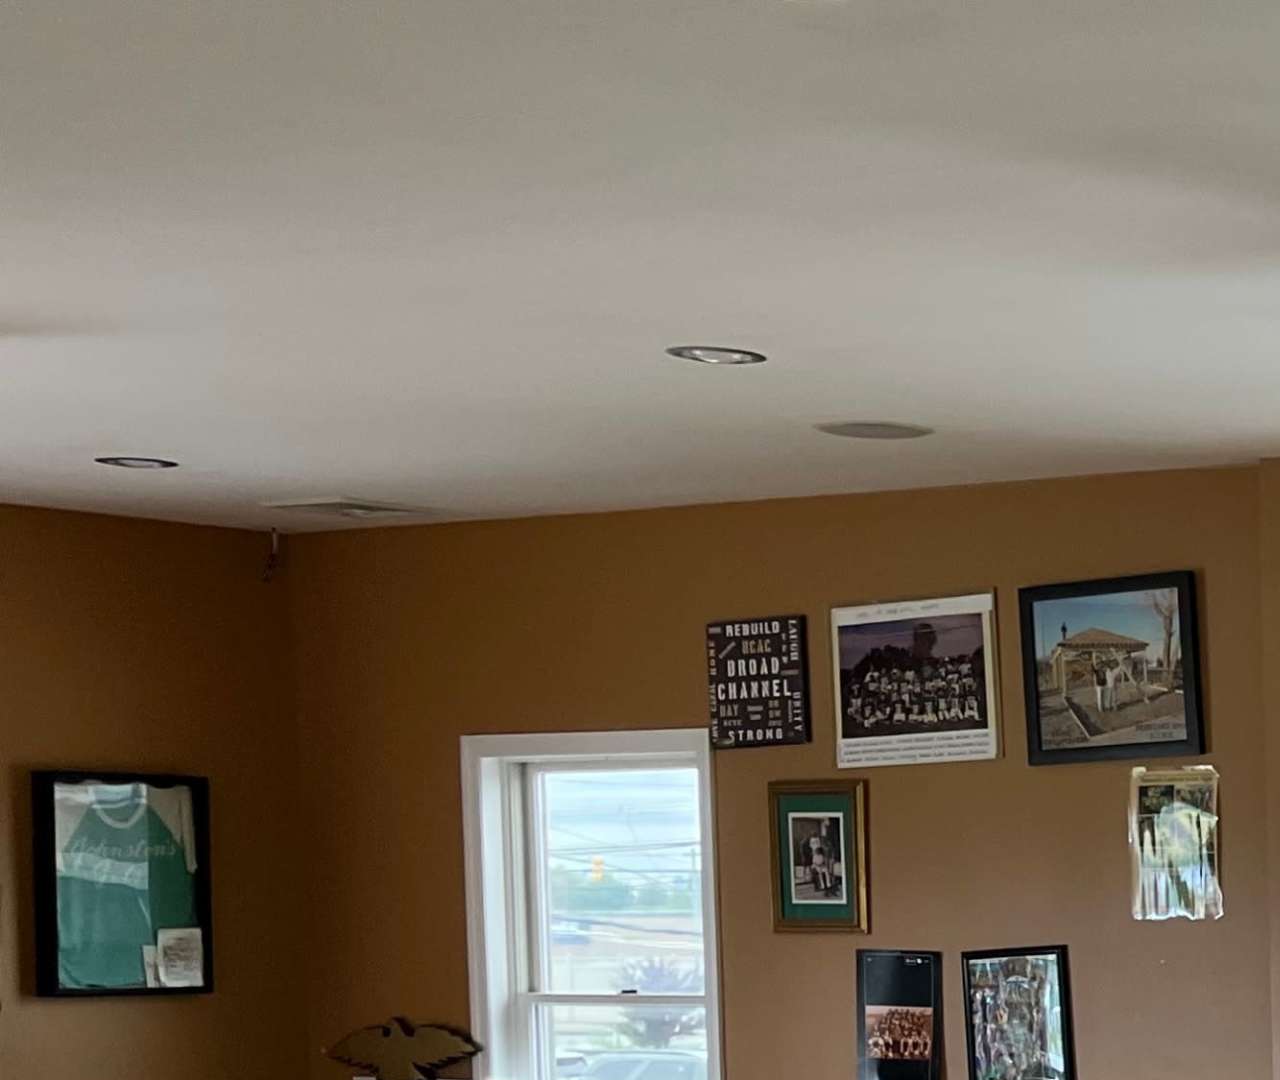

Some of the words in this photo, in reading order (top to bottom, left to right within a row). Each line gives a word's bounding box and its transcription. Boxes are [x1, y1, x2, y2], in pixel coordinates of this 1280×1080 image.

[725, 620, 780, 637] REBUILD
[727, 657, 780, 677] BROAD
[717, 679, 792, 700] CHANNEL
[728, 728, 783, 742] STRONG
